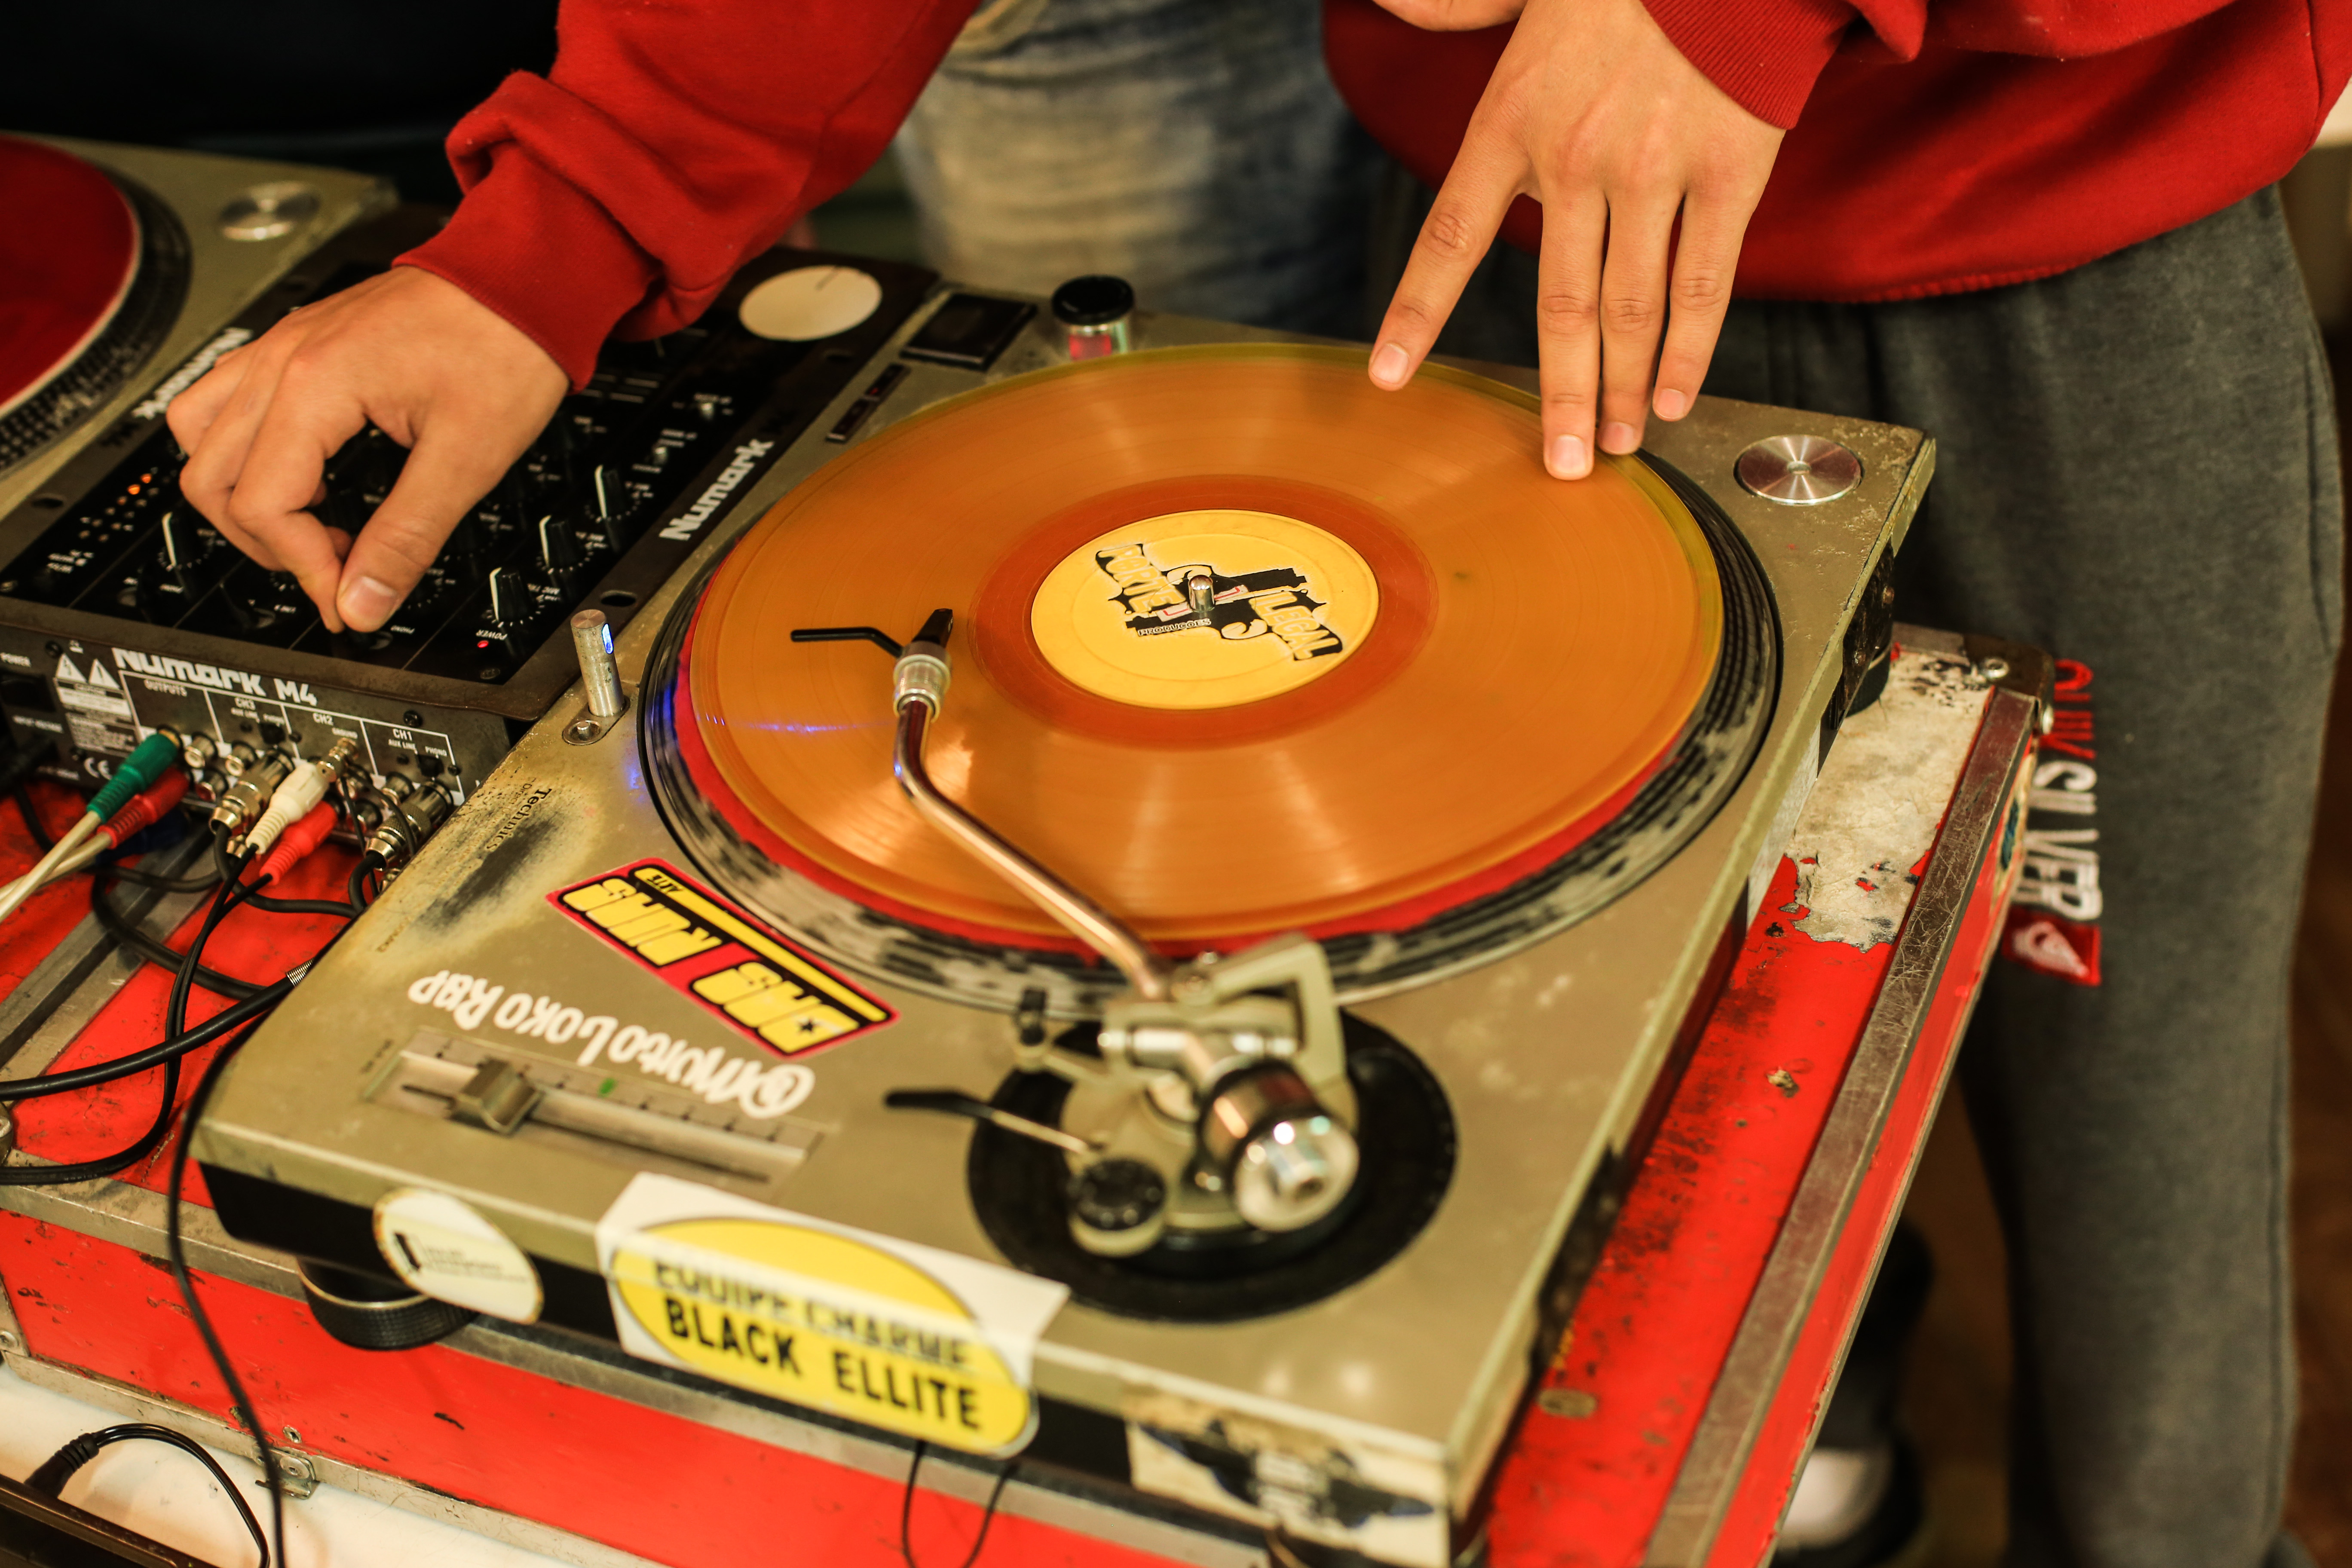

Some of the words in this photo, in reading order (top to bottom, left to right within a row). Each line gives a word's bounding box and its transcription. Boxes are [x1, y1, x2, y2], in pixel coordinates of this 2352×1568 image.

[658, 438, 774, 541] Numark
[1098, 544, 1186, 613] PORTE
[476, 628, 508, 641] POWER
[1249, 591, 1339, 660] ILEGAL
[111, 647, 266, 697] Numark
[273, 678, 318, 707] M4
[144, 679, 188, 697] OUTPUTS
[312, 712, 334, 726] CH2
[388, 738, 401, 748] AUX
[402, 741, 416, 751] LINE
[392, 728, 413, 741] CH1
[424, 746, 447, 757] PHONO
[487, 788, 552, 849] Technics
[562, 878, 723, 966] RUAS
[692, 961, 859, 1053] DAS
[665, 1296, 802, 1378] BLACK
[833, 1349, 980, 1430] ELLITE
